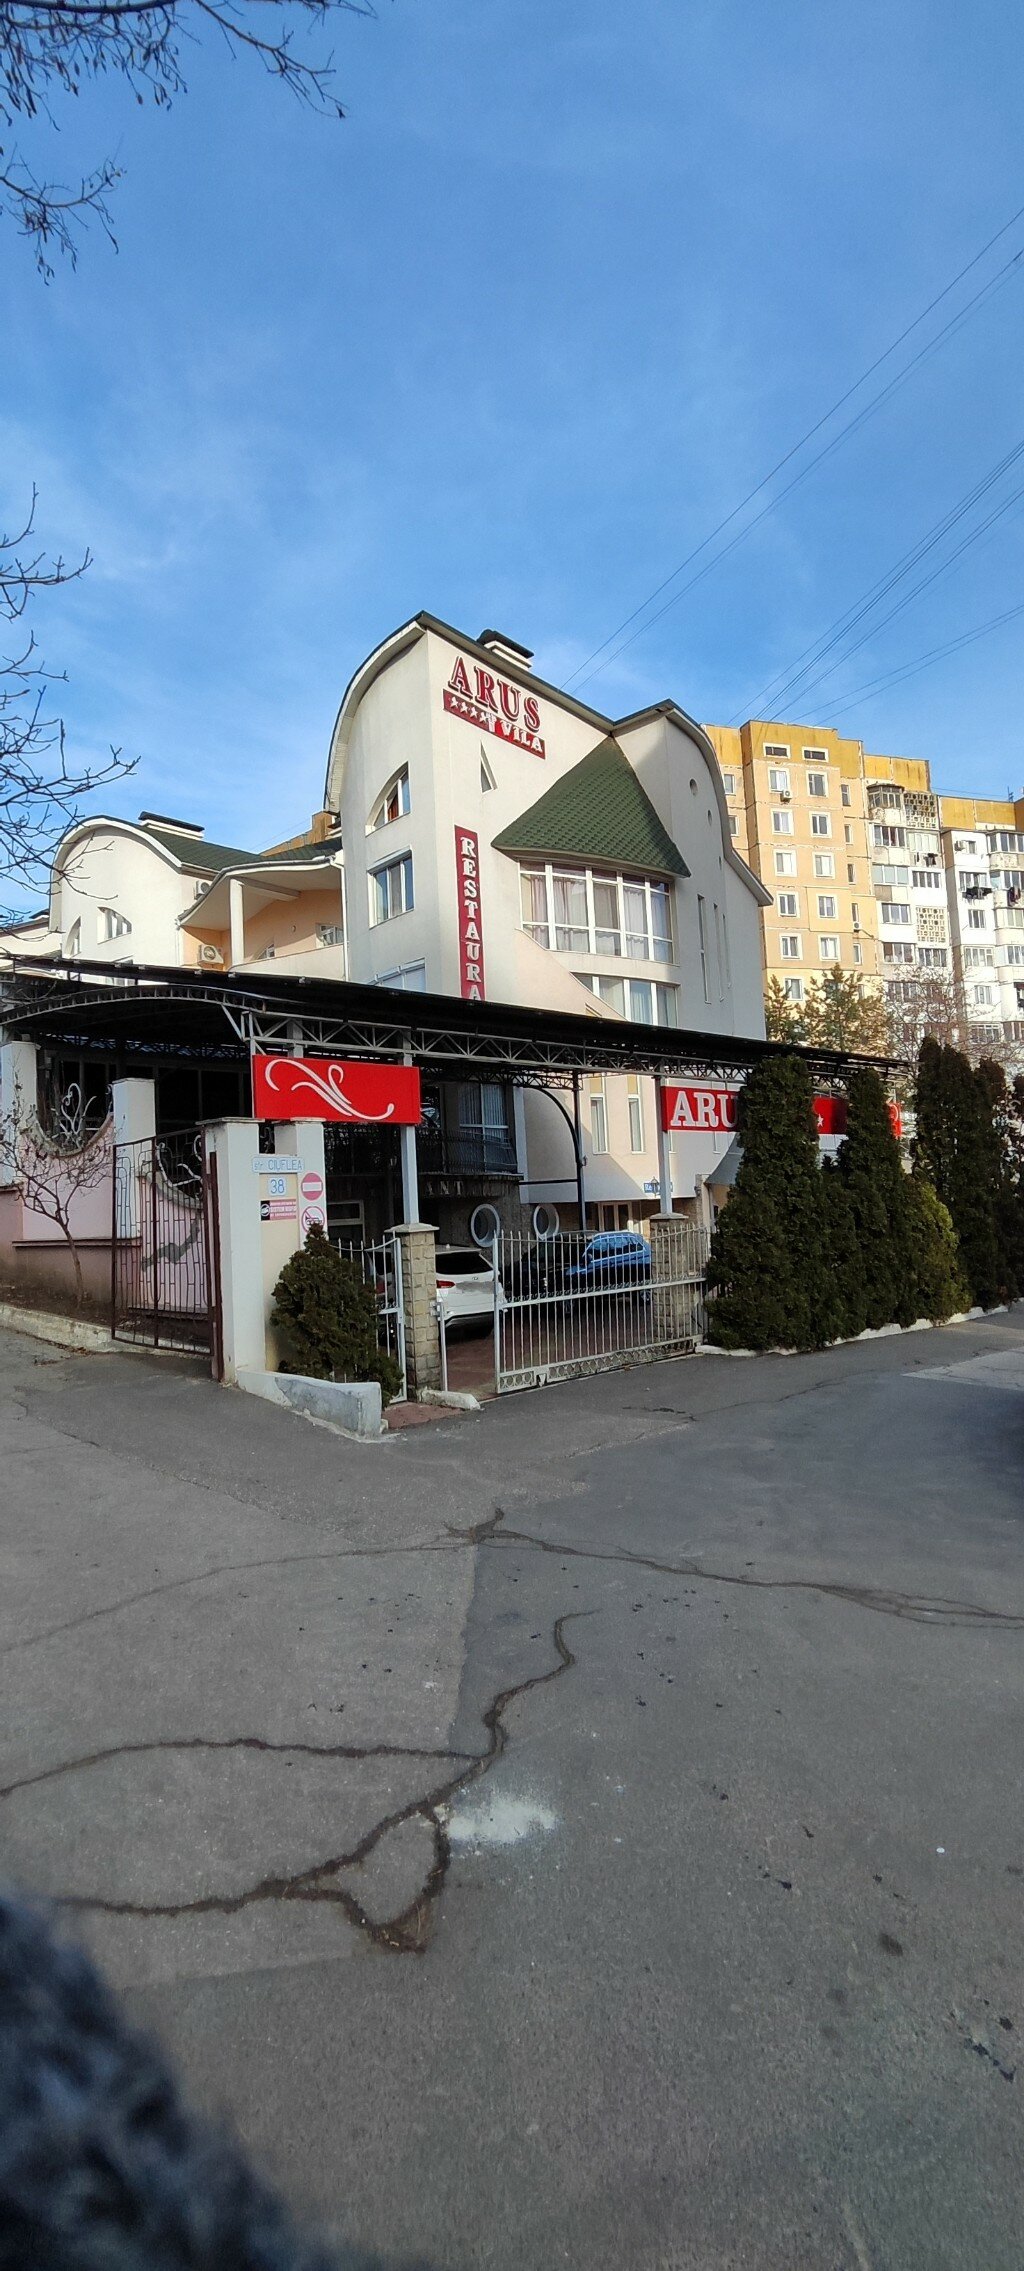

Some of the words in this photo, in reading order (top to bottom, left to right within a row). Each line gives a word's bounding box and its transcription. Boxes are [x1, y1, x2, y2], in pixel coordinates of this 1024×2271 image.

[448, 656, 541, 733] ARUS
[501, 720, 543, 752] VILA
[270, 1179, 285, 1194] 38
